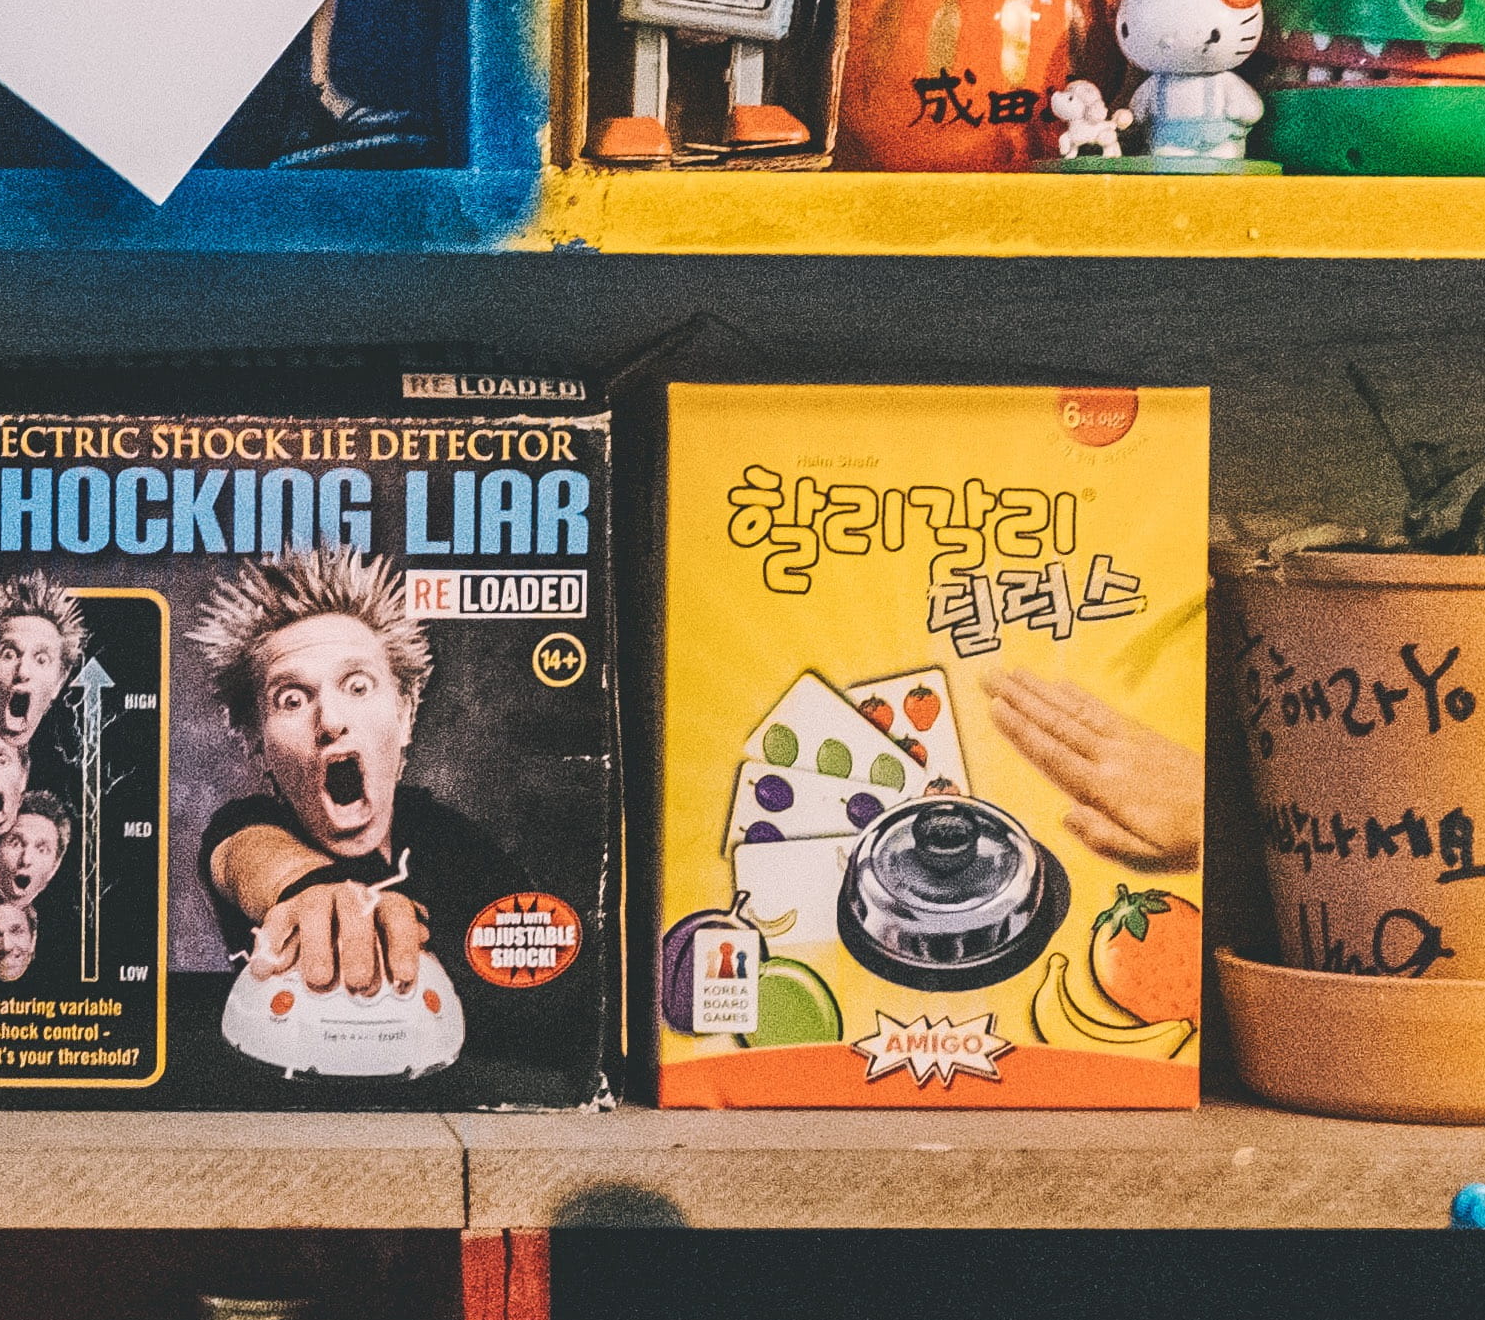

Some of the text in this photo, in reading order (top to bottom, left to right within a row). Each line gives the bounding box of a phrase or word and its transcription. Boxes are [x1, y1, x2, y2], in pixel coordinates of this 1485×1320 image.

[908, 67, 1060, 129] 成田
[461, 378, 577, 398] LOADED
[149, 423, 286, 461] SHOCK
[302, 425, 356, 461] LIE
[368, 425, 579, 463] DETECTOR
[403, 467, 591, 557] LIAR
[727, 464, 1078, 596] 할리갈리
[462, 576, 581, 614] LOADED
[539, 647, 579, 674] 14+
[124, 692, 158, 712] HIGH
[123, 821, 153, 839] MED
[471, 925, 578, 948] ADJUSTABLE
[119, 965, 149, 983] LOW
[703, 985, 750, 997] KOREA
[59, 996, 123, 1018] variable
[703, 999, 750, 1010] BOARD
[43, 1024, 99, 1041] control
[885, 1032, 984, 1055] AMIGO
[16, 1050, 54, 1070] your
[57, 1045, 140, 1067] threshold?
